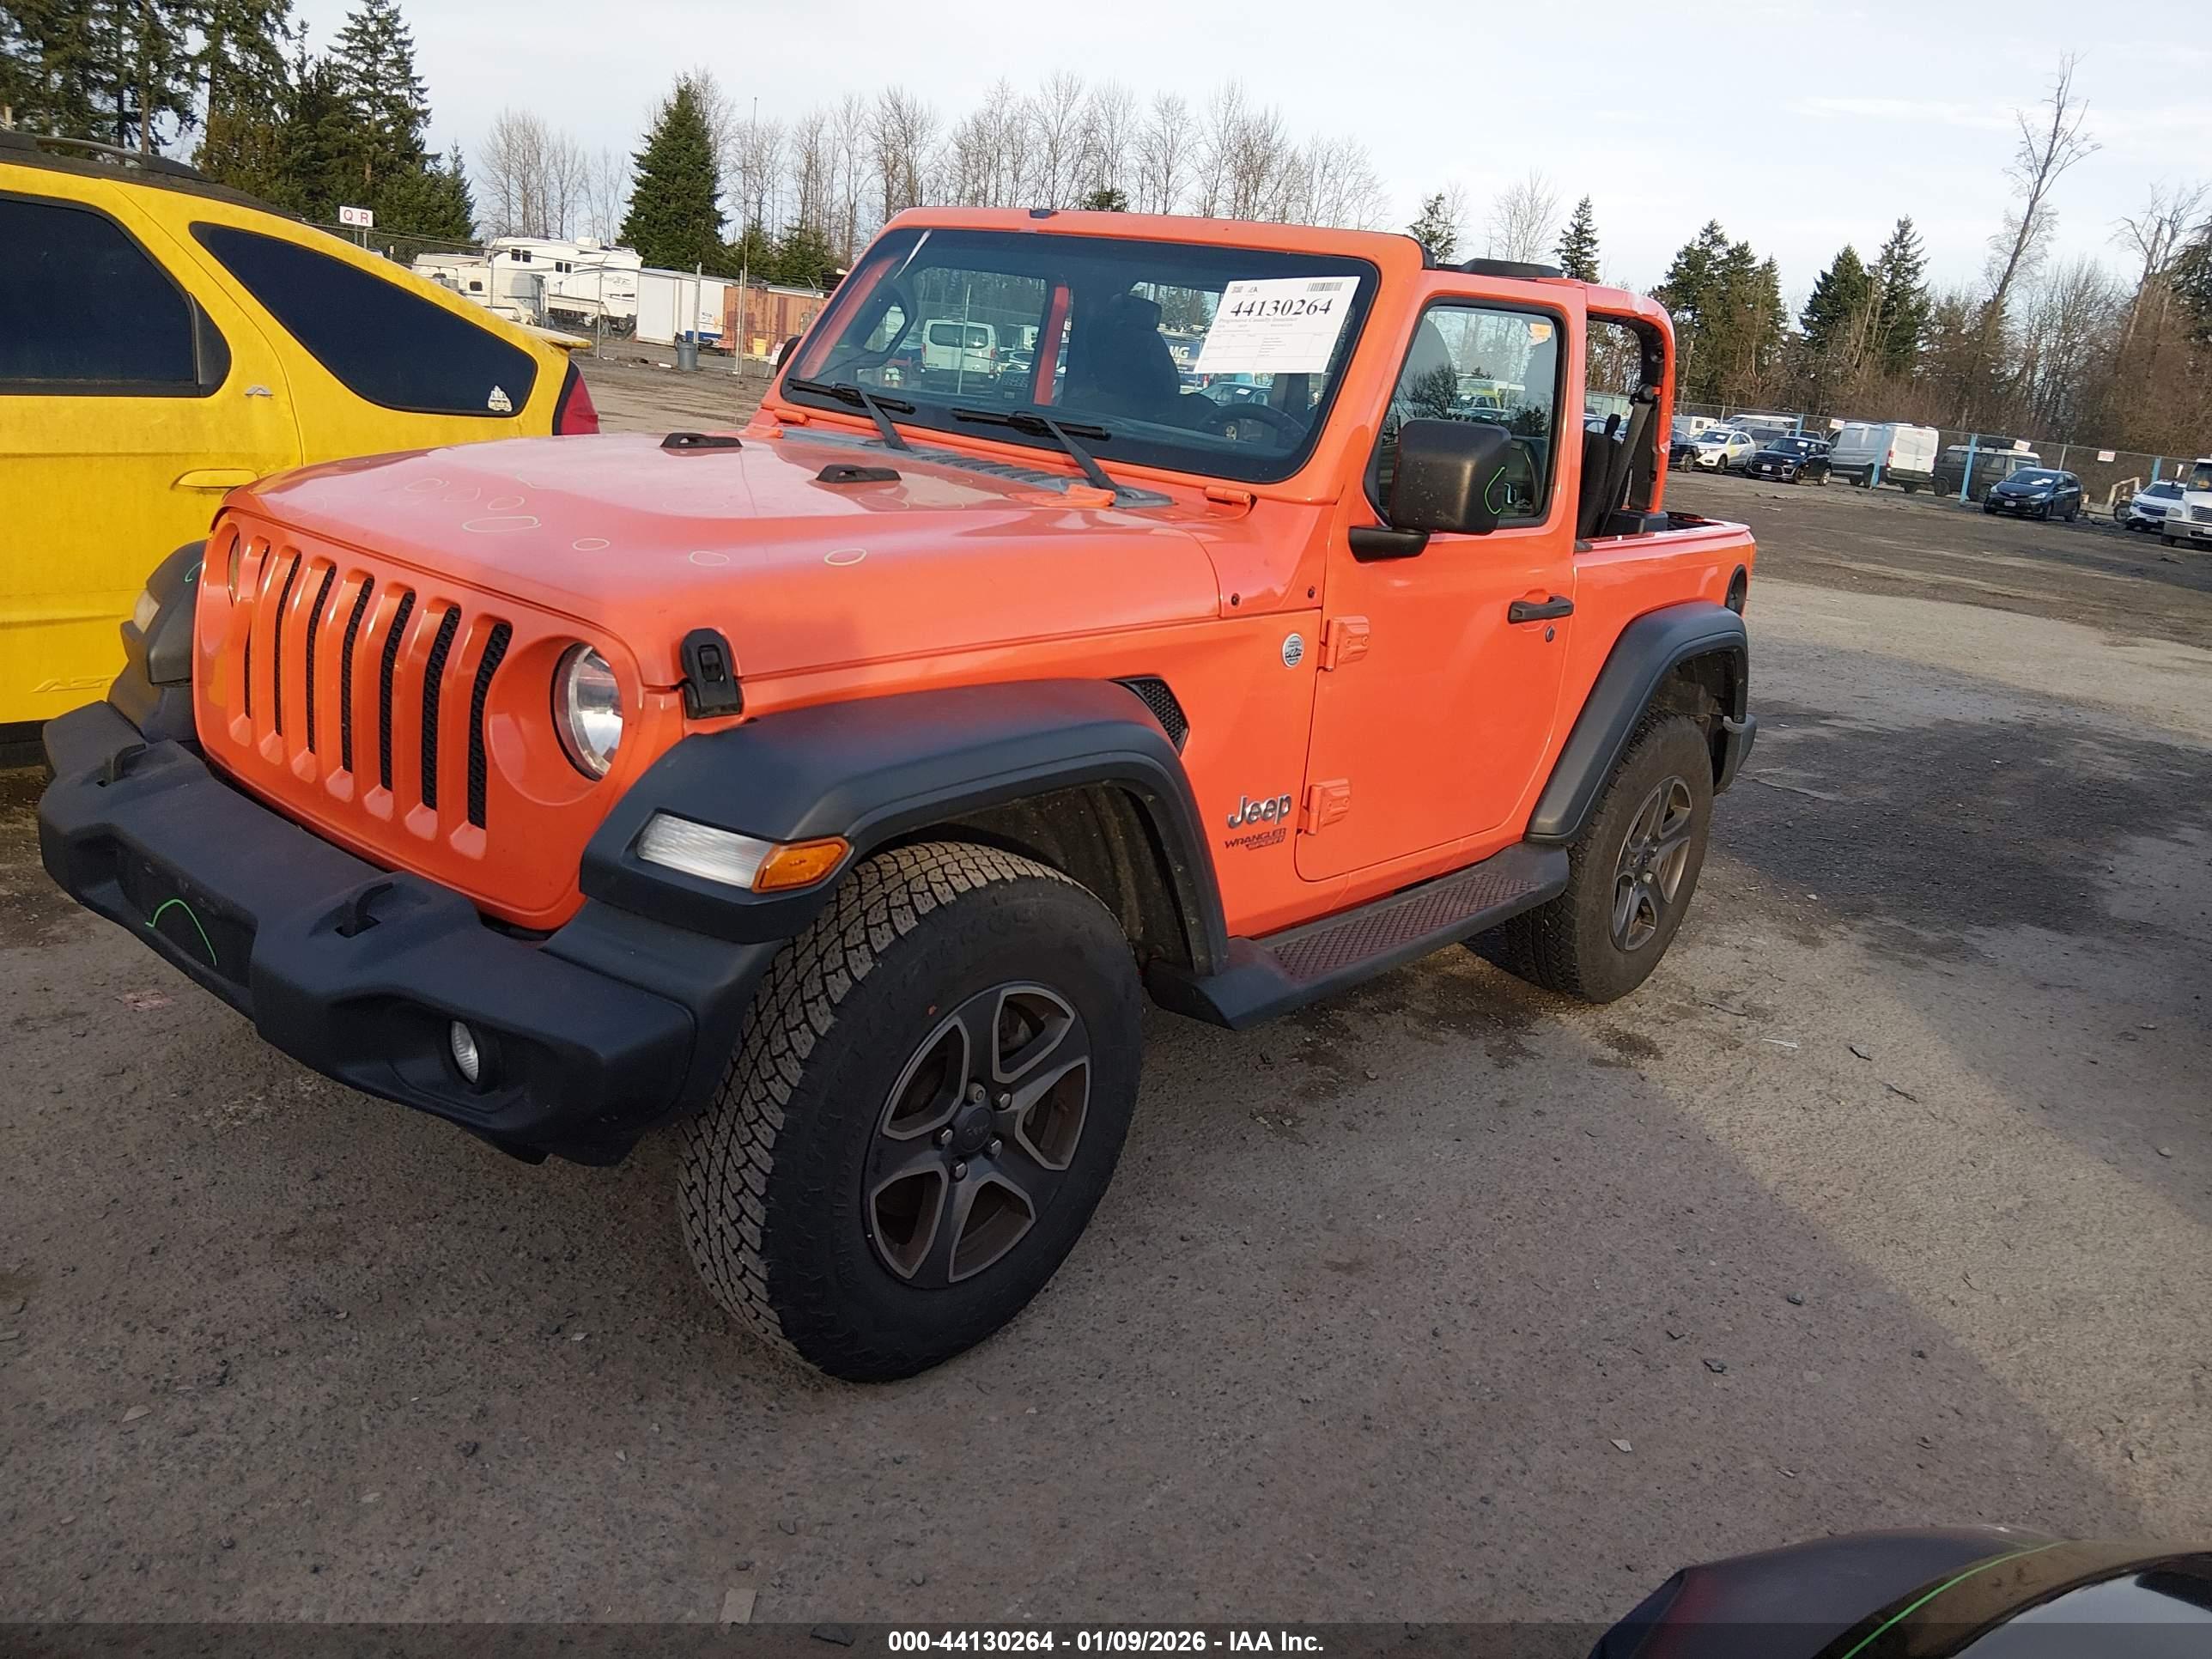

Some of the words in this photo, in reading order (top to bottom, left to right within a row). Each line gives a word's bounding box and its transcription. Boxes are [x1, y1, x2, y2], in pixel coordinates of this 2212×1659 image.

[343, 209, 353, 222] Q
[361, 211, 368, 223] R
[1231, 298, 1333, 316] 44130264
[1228, 794, 1291, 828] Jeep
[1224, 827, 1286, 849] WRANGLER
